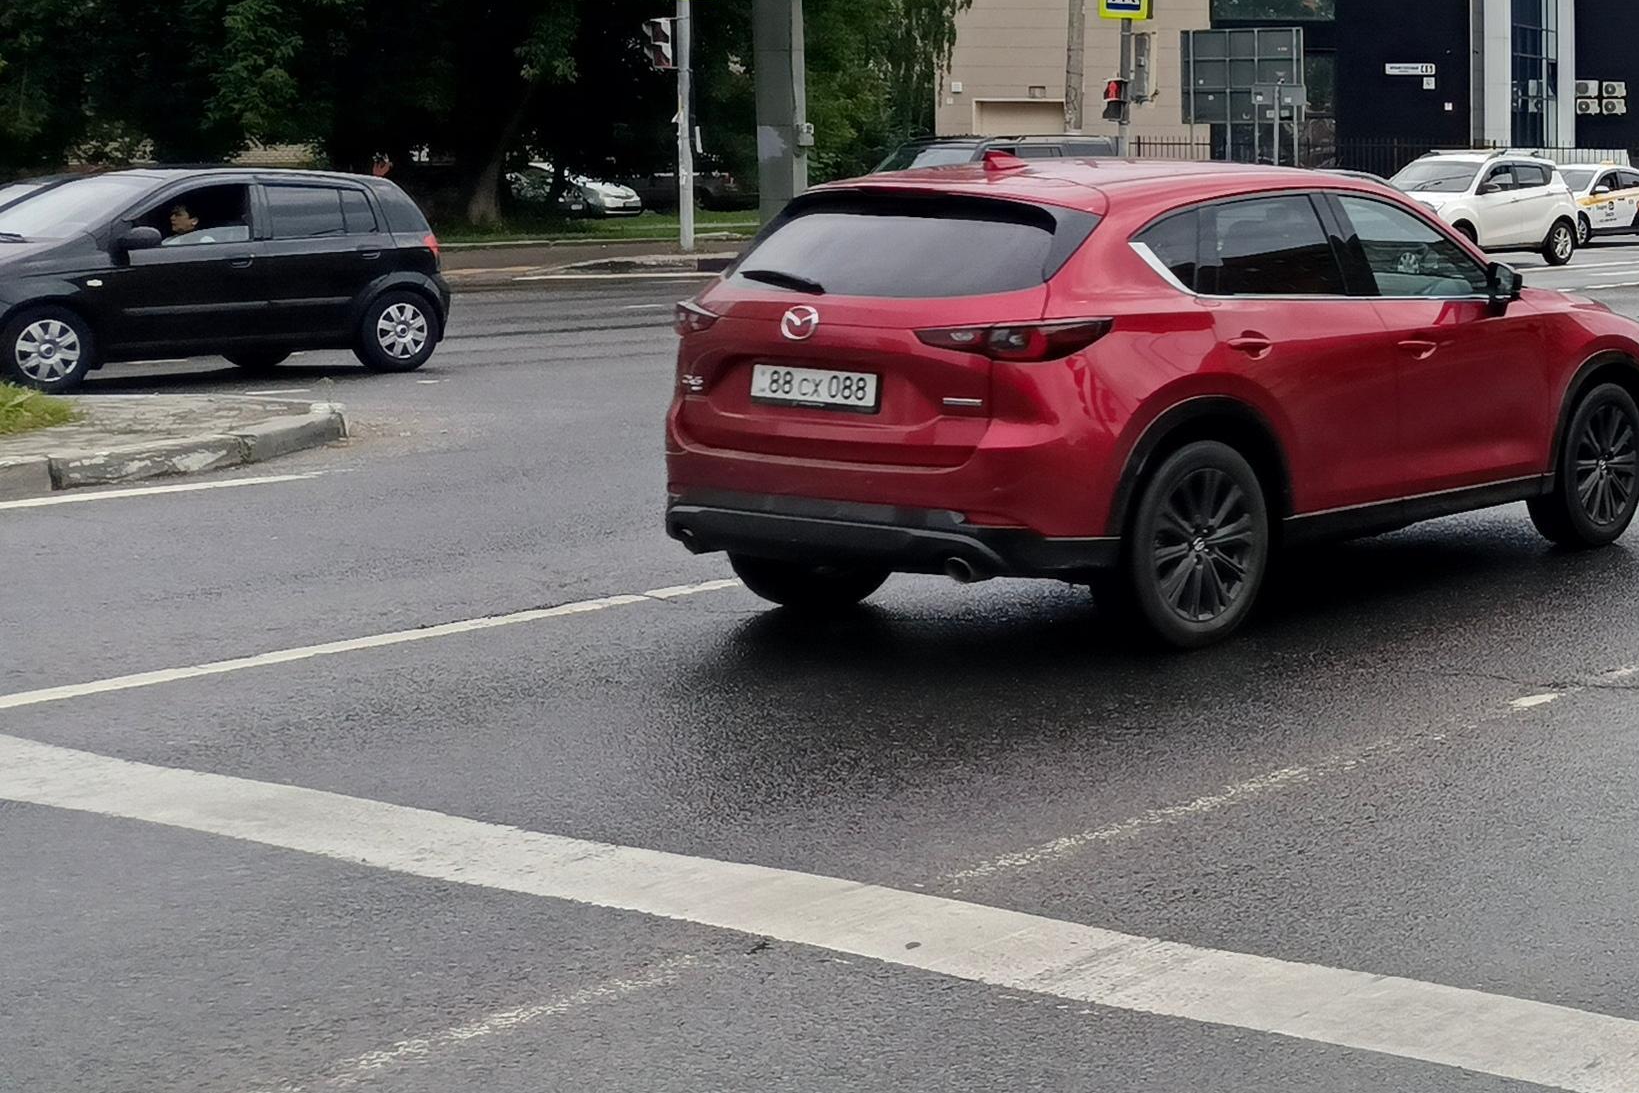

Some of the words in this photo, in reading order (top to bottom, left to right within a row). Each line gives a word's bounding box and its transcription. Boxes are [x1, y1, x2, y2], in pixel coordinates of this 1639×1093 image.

[769, 370, 794, 395] 88
[799, 378, 823, 397] CX
[828, 375, 868, 401] 088
